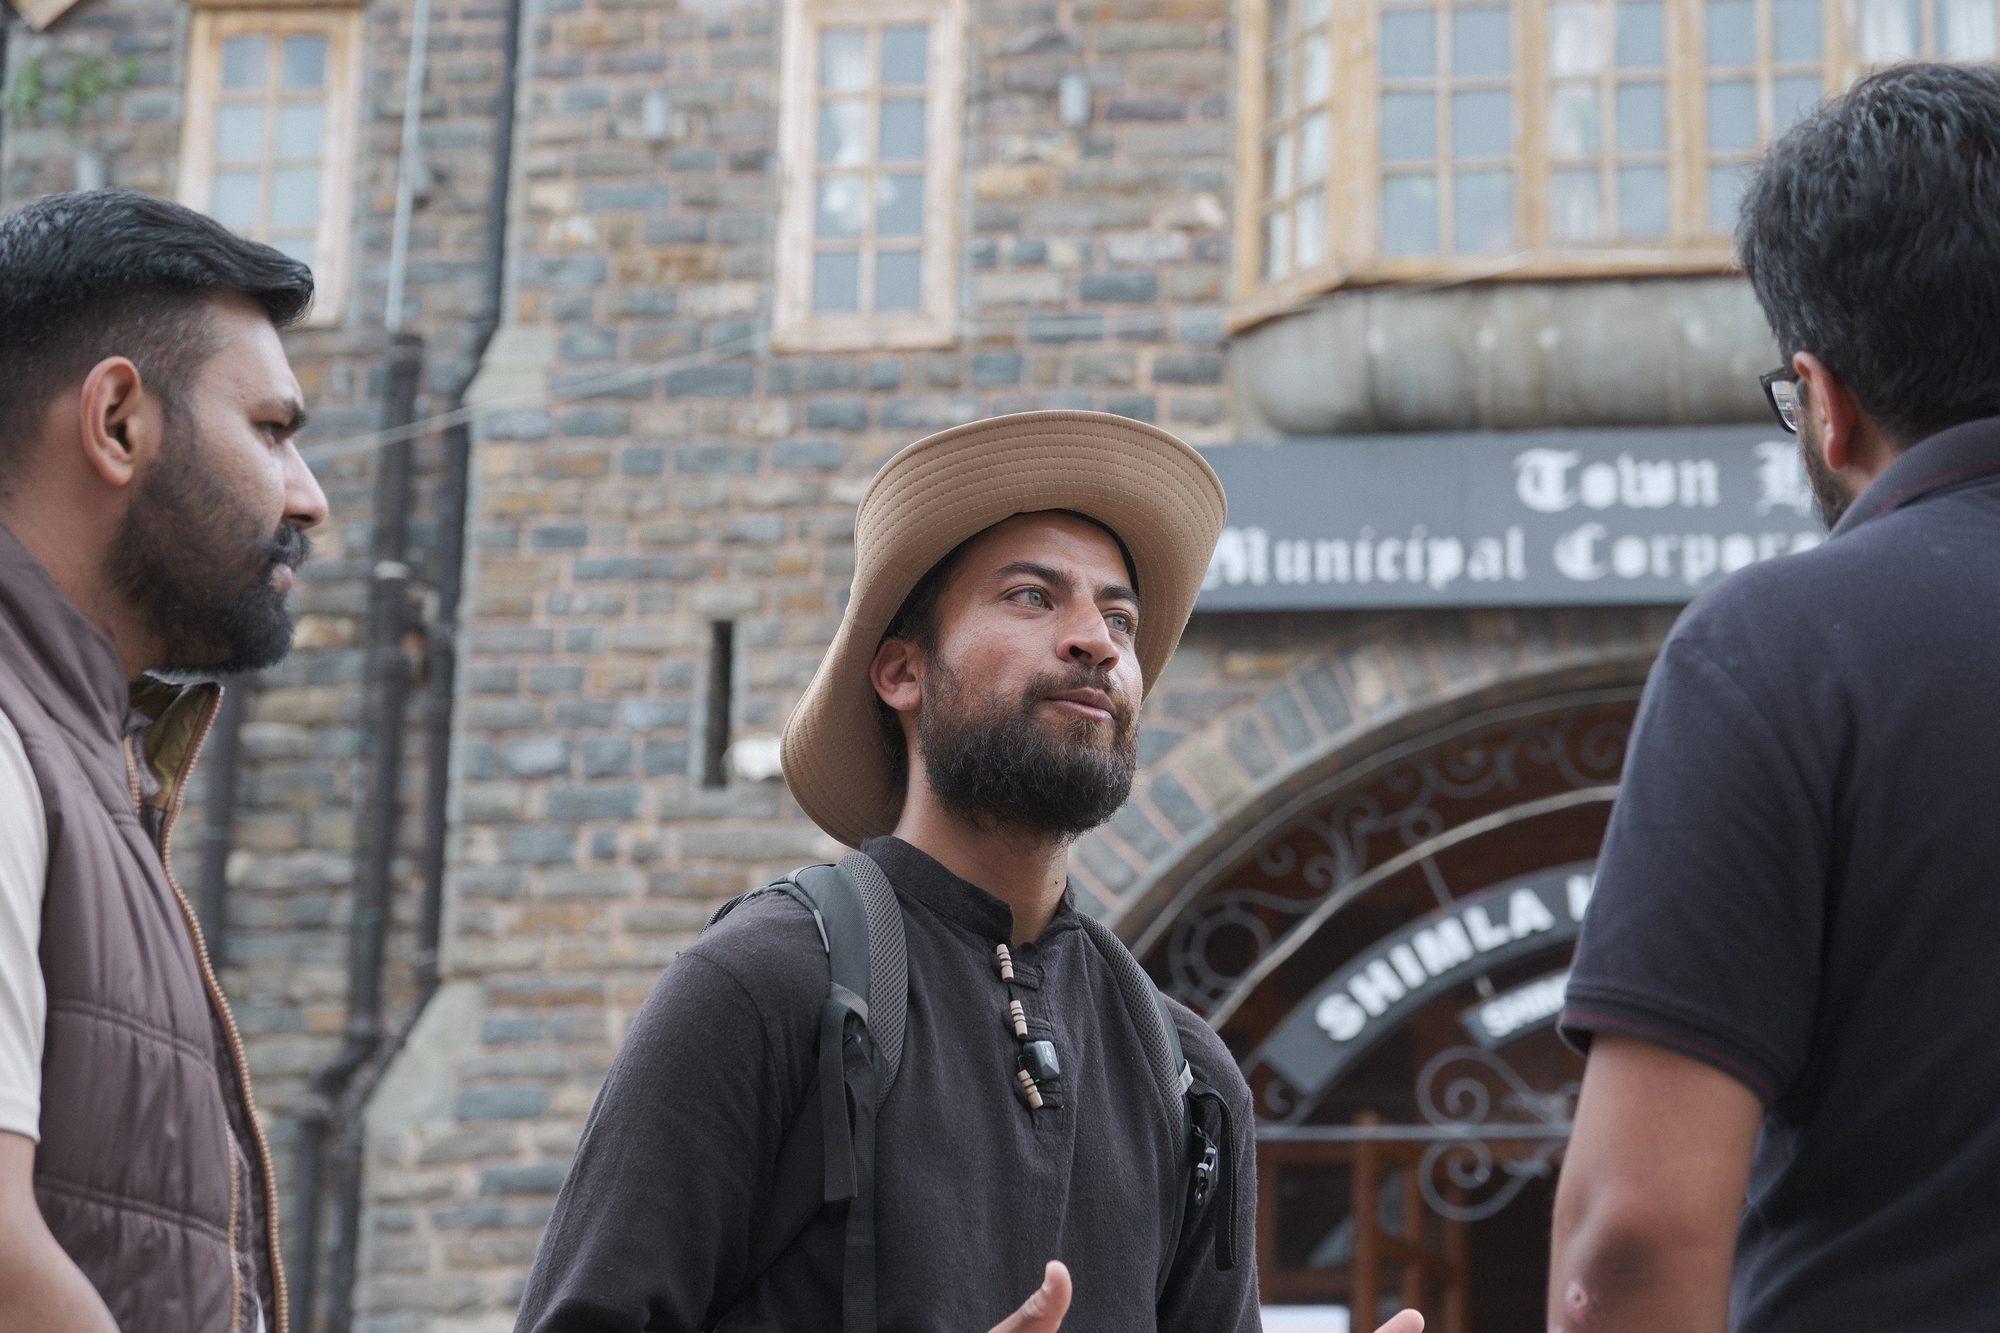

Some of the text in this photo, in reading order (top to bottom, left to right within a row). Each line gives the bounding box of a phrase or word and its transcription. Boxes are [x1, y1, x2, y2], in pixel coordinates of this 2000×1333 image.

[1514, 448, 1720, 511] Town
[1200, 524, 1526, 588] Municipal
[1315, 888, 1556, 1042] SHIMLA
